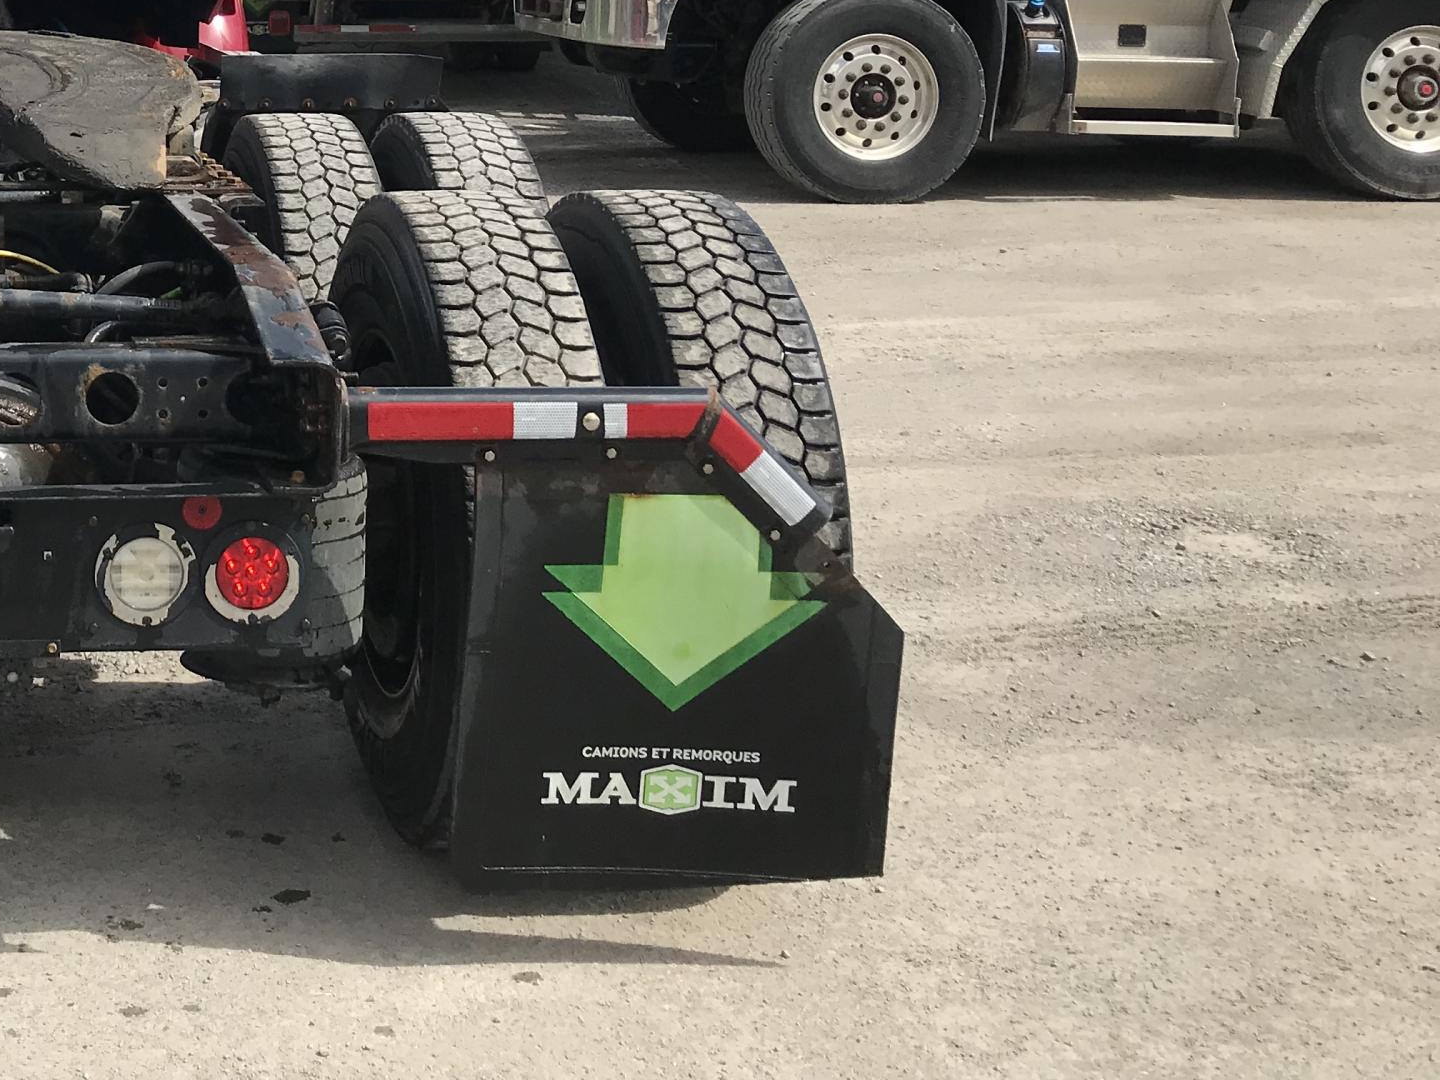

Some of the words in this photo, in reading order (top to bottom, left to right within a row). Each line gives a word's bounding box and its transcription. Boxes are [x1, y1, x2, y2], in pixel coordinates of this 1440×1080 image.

[581, 746, 648, 759] CAMIONS
[651, 747, 670, 759] ET
[672, 748, 761, 764] REMORQUES
[540, 764, 798, 816] MAXIM
